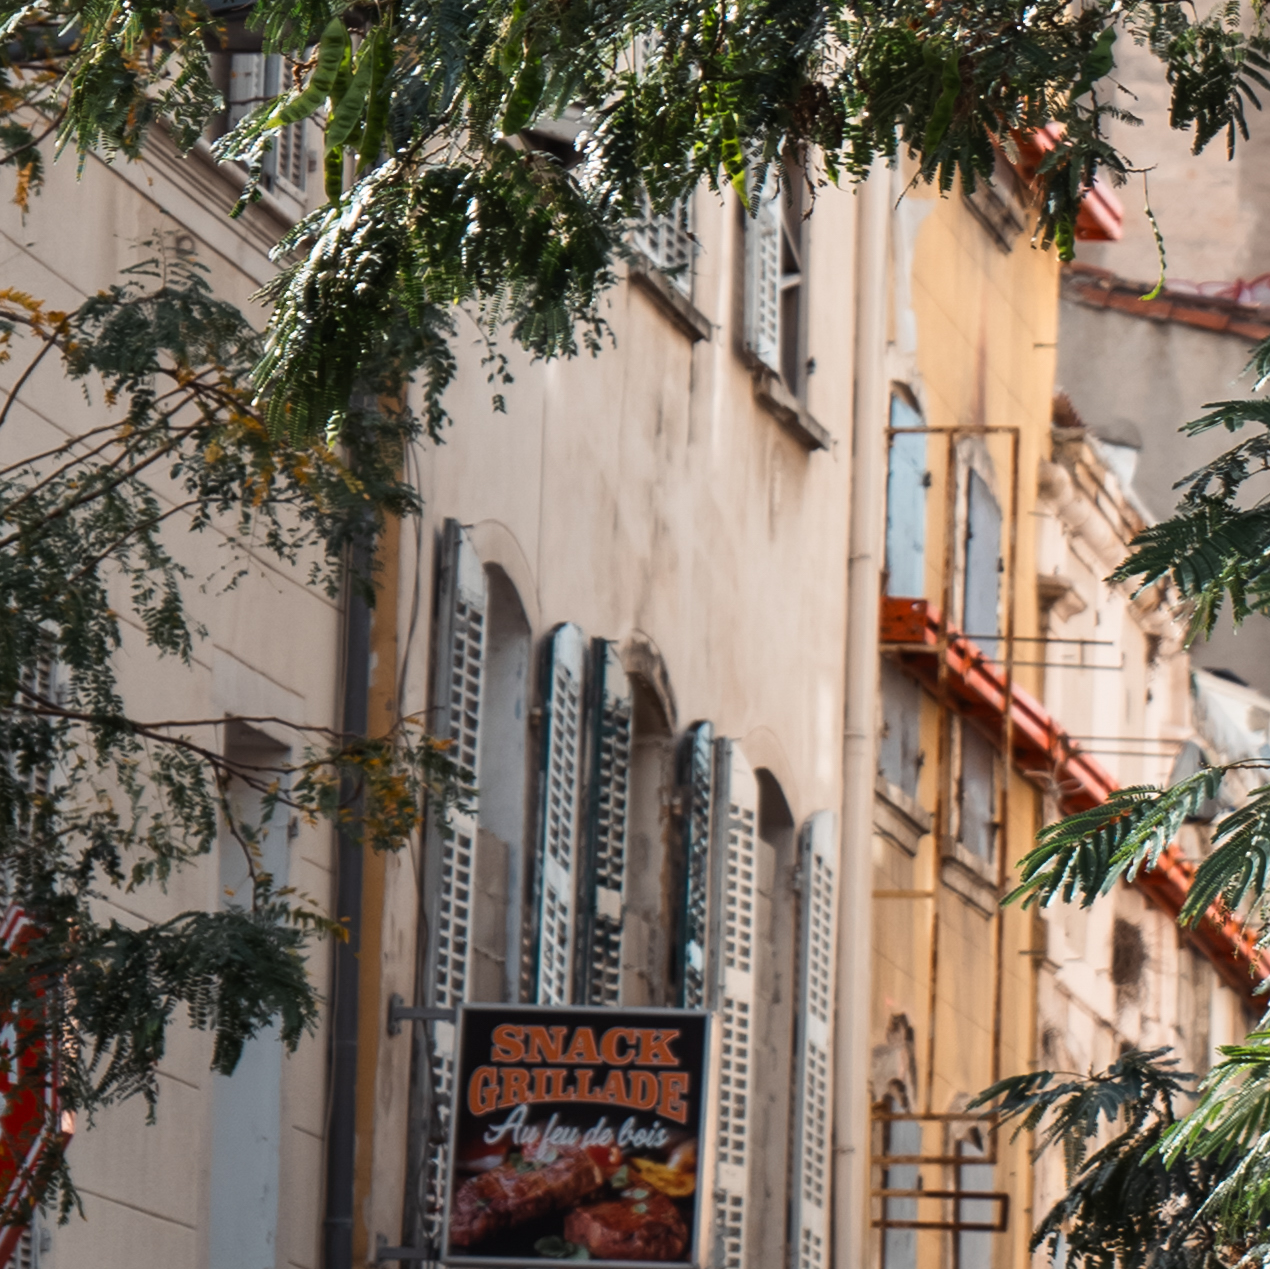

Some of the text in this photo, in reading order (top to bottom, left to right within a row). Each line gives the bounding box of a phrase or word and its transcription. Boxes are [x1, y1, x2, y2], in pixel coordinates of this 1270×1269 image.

[490, 1023, 681, 1067] SNACK
[468, 1065, 690, 1124] GRILLADE
[483, 1104, 670, 1159] Au feu de bois
